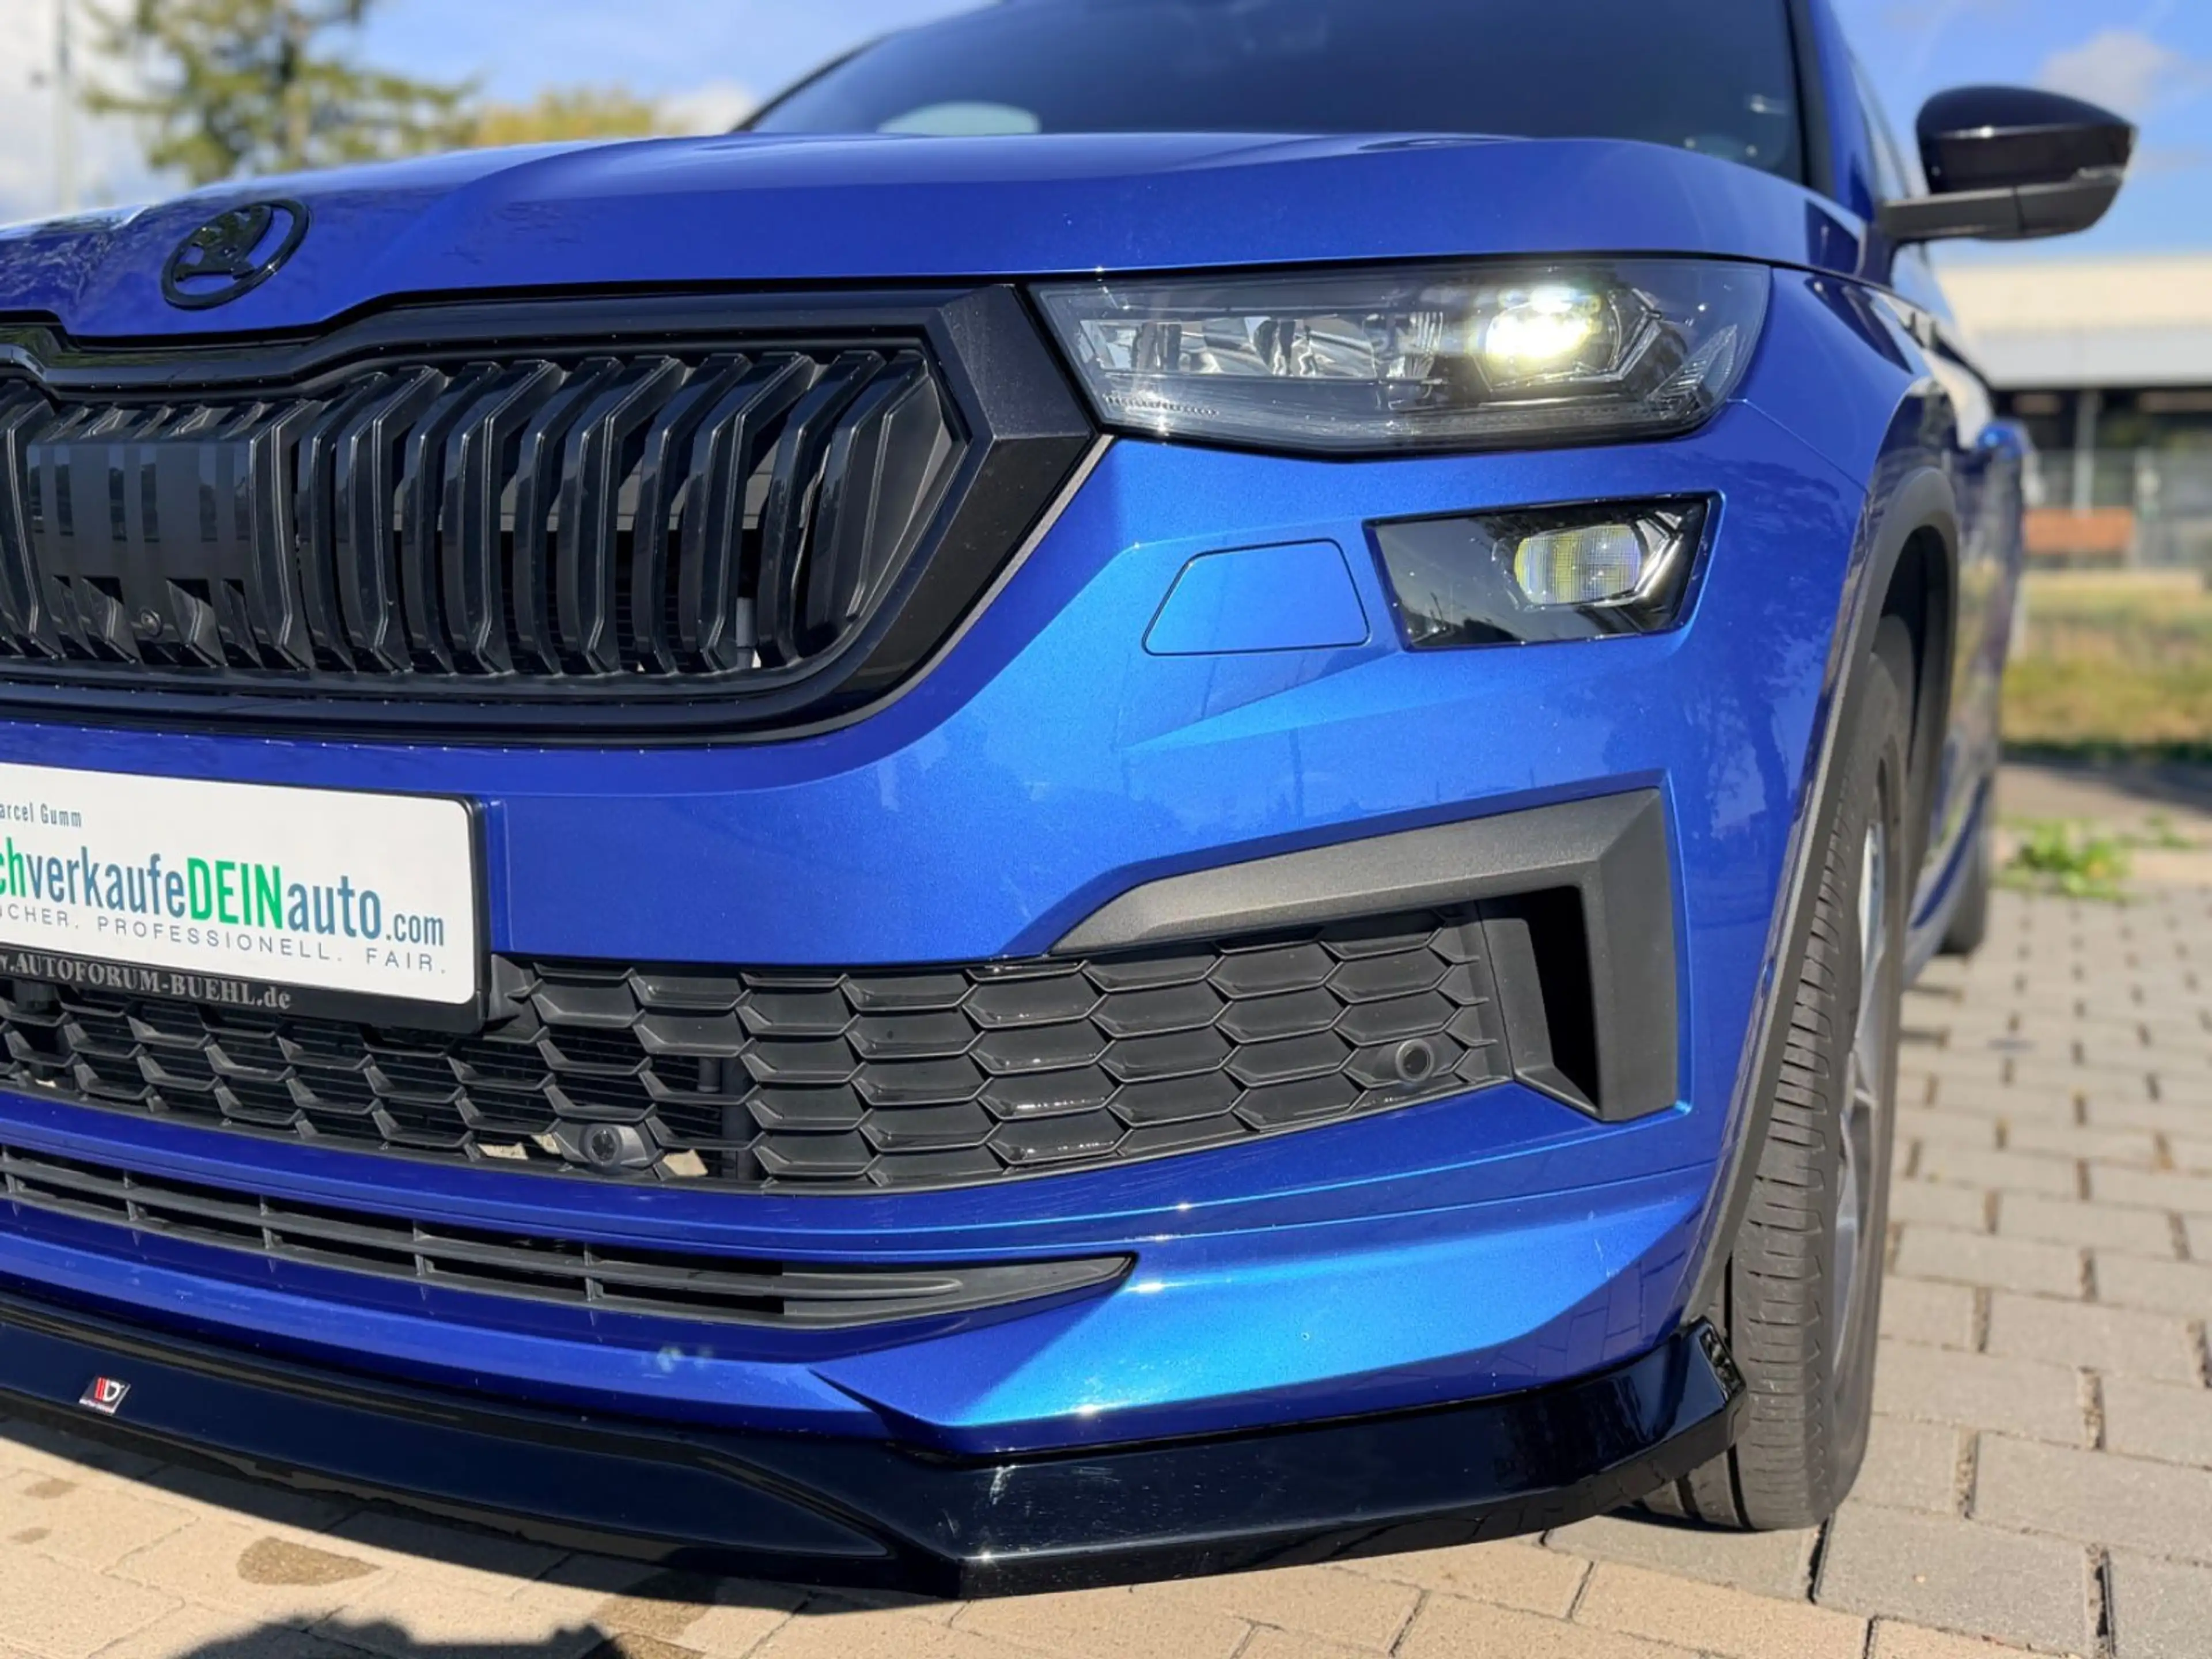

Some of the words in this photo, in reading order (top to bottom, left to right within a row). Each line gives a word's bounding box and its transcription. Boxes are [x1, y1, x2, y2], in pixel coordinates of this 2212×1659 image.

[40, 803, 82, 827] Gumm
[97, 916, 342, 961] PROFESSIONELL.
[366, 948, 446, 974] FAIR.
